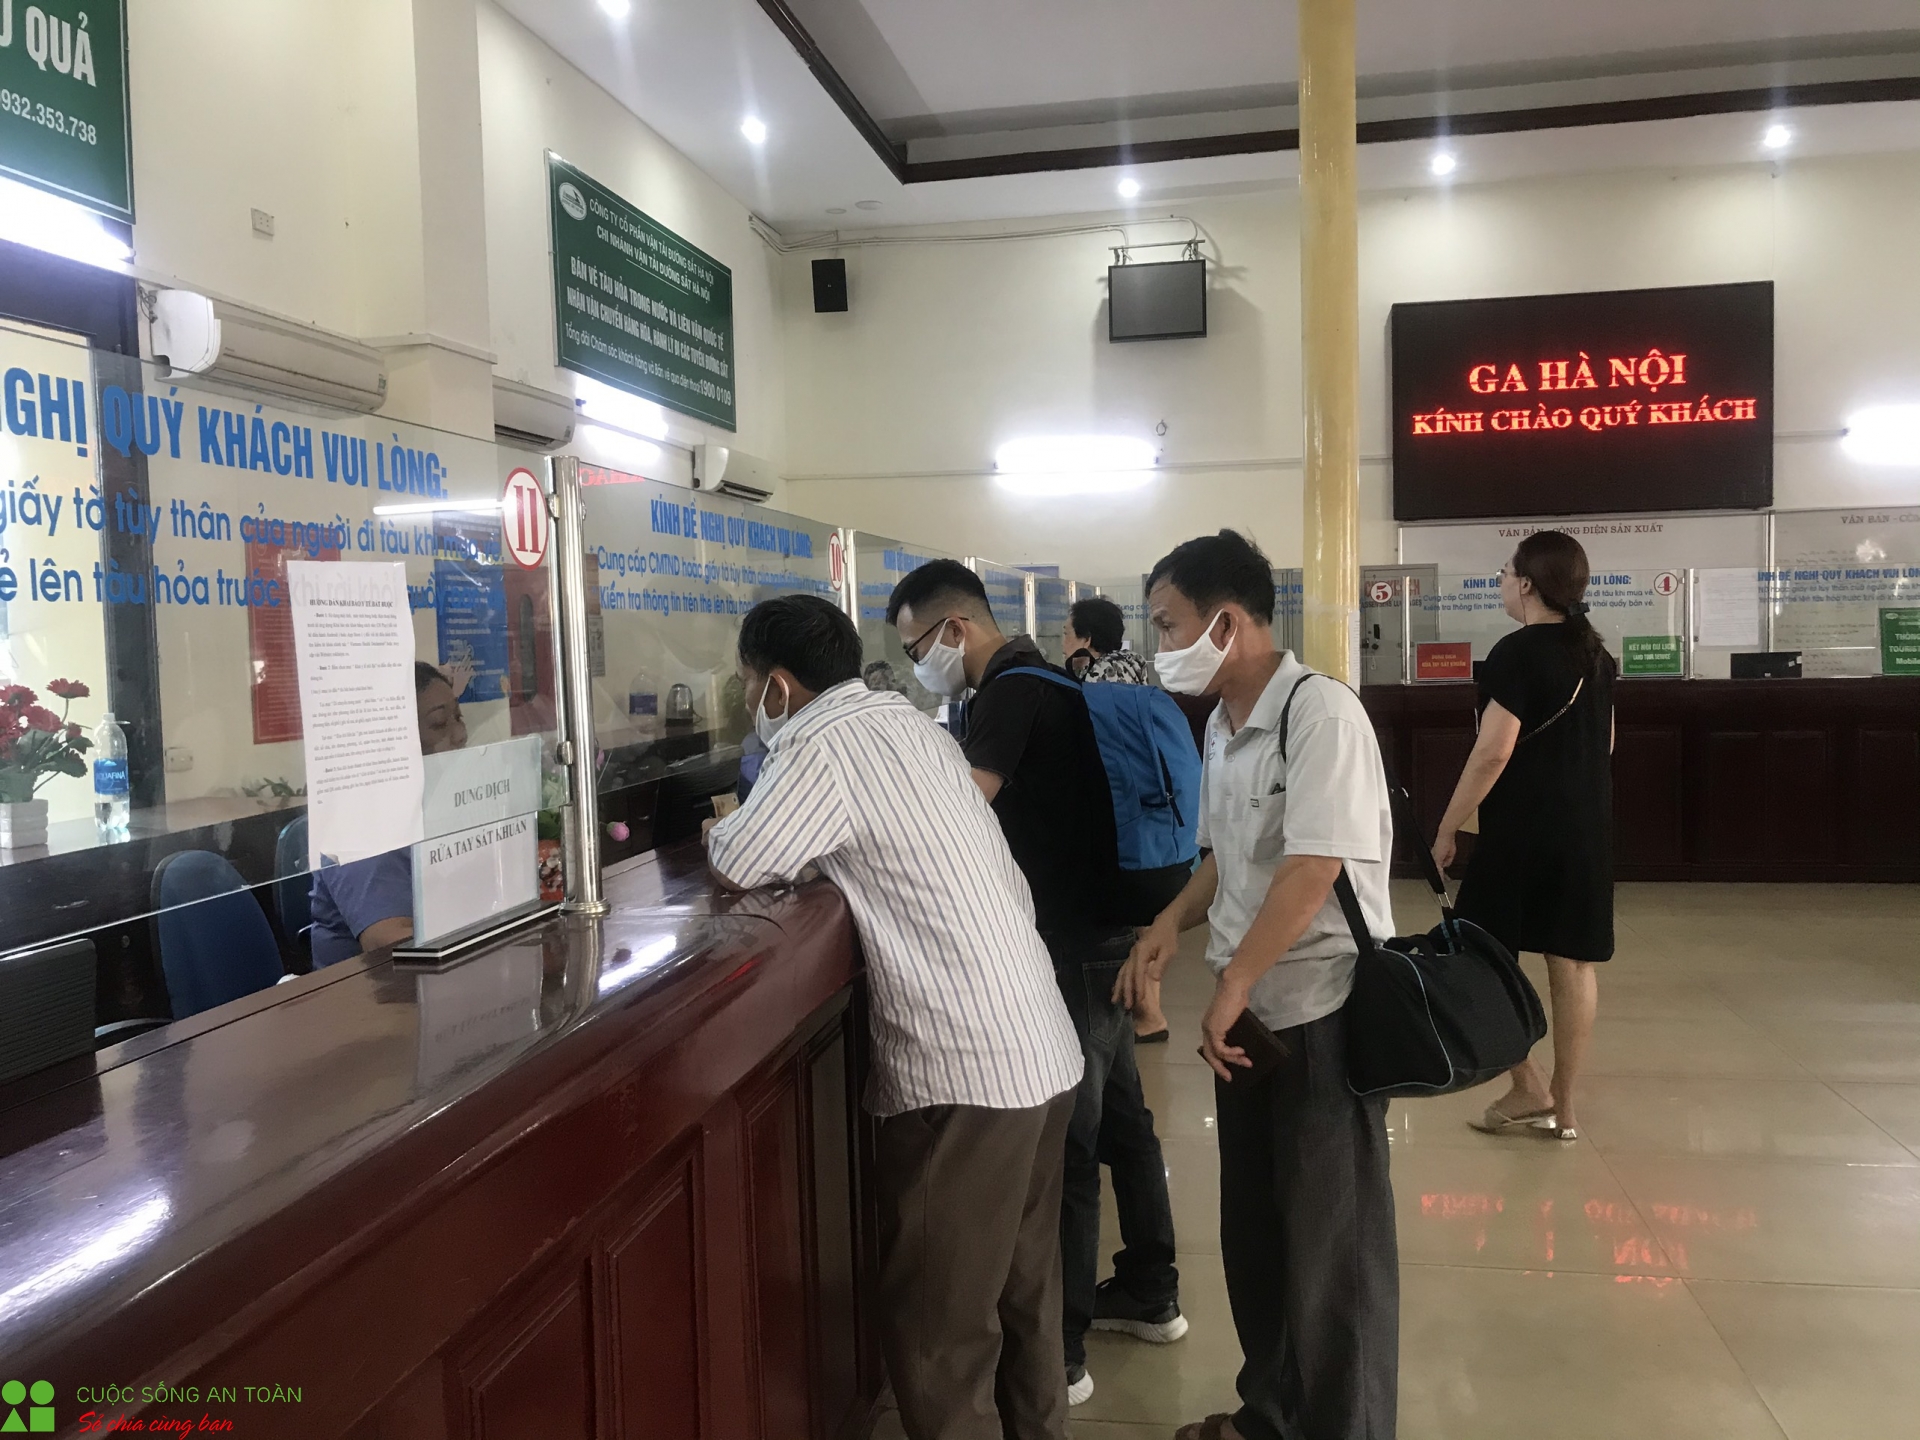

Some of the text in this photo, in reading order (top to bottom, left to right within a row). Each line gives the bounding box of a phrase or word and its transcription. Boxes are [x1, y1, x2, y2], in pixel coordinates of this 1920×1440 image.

[26, 5, 97, 87] QUẢ
[1, 88, 97, 146] 932.353.738
[589, 198, 609, 221] CÔNG
[609, 210, 619, 226] TY
[619, 214, 629, 233] CỔ
[645, 233, 658, 252] VẬN
[596, 224, 609, 243] CHI
[609, 231, 634, 258] NHÁNH
[633, 247, 648, 267] VẬN
[648, 253, 659, 272] TẢI
[566, 285, 586, 314] NHẬN
[586, 294, 600, 321] VẬN
[570, 255, 588, 282] BÁN
[588, 264, 599, 288] VÉ
[599, 269, 614, 295] TÀU
[614, 275, 629, 304] HỎA
[628, 287, 651, 315] TRONG
[1468, 348, 1687, 394] GA HÀ NỘI
[716, 385, 732, 407] 0109
[1412, 394, 1757, 435] KÍNH CHÀO QUÝ KHÁCH
[0, 367, 449, 500] GHỊ QUÝ KHÁCH VUI LÒNG:
[73, 484, 106, 531] tờ
[114, 487, 162, 545] tùy
[170, 498, 232, 541] thân
[239, 502, 286, 544] của
[292, 512, 352, 557] người
[357, 518, 375, 552] đi
[379, 518, 410, 555] tàu
[413, 524, 439, 557] khi
[513, 484, 542, 554] 11
[651, 493, 681, 536] KÍNH
[683, 497, 698, 539] ĐỀ
[699, 510, 726, 550] NGHỊ
[727, 512, 746, 549] QUÝ
[747, 516, 776, 553] KHÁCH
[1583, 524, 1608, 536] ĐIỆN
[1611, 522, 1633, 534] SẢN
[1634, 521, 1664, 533] XUẤT
[597, 545, 625, 577] Cung
[627, 546, 647, 577] cấp
[831, 542, 842, 582] 10
[1603, 573, 1632, 586] LÒNG:
[29, 557, 84, 602] lên
[93, 557, 146, 605] tàu
[154, 559, 209, 606] hỏa
[216, 568, 281, 608] trước
[627, 586, 641, 610] tra
[643, 588, 670, 617] thông
[671, 590, 682, 612] tin
[1376, 584, 1389, 600] 5
[1463, 577, 1486, 589] KÍNH
[1657, 576, 1671, 592] 4
[454, 778, 511, 808] DUNG DỊCH
[429, 843, 453, 866] RỬA
[454, 836, 474, 856] TAY
[475, 828, 494, 849] SÁT
